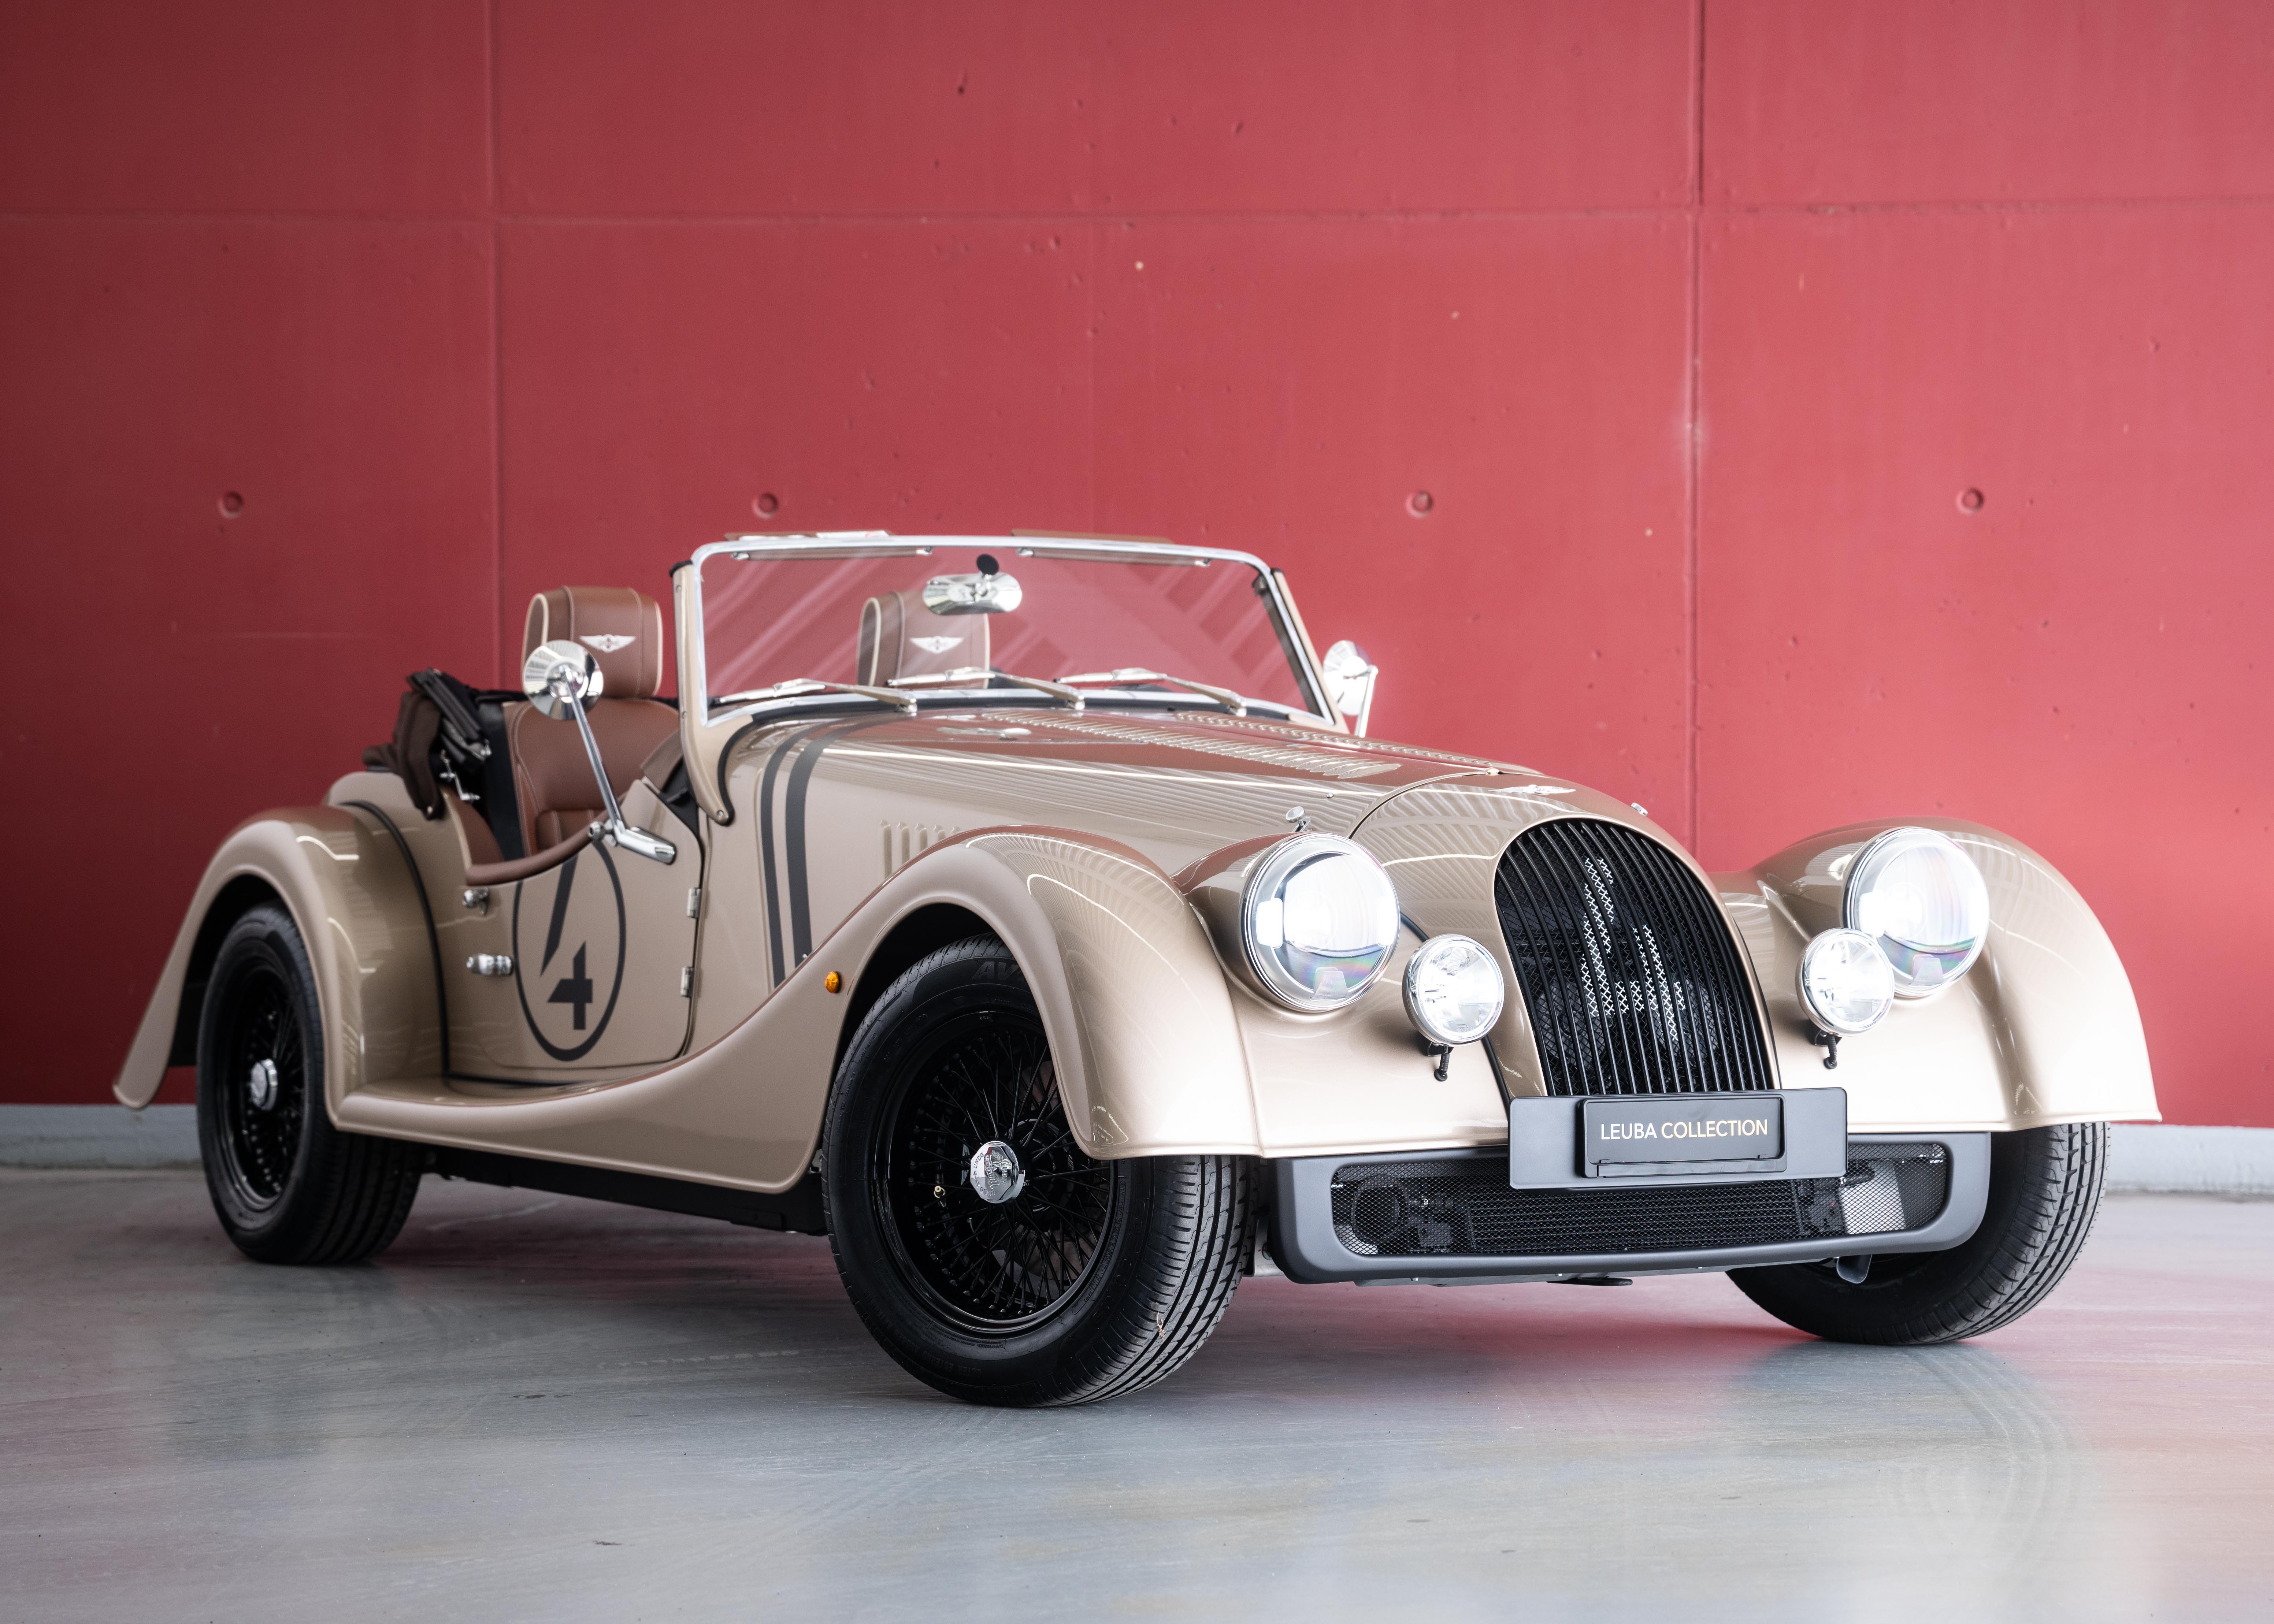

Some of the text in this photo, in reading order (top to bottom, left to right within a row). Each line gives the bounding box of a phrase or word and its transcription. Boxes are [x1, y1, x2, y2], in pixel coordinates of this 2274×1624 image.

[1601, 1119, 1768, 1140] LEUBA COLLECTION
[973, 1152, 984, 1169] UNDO
